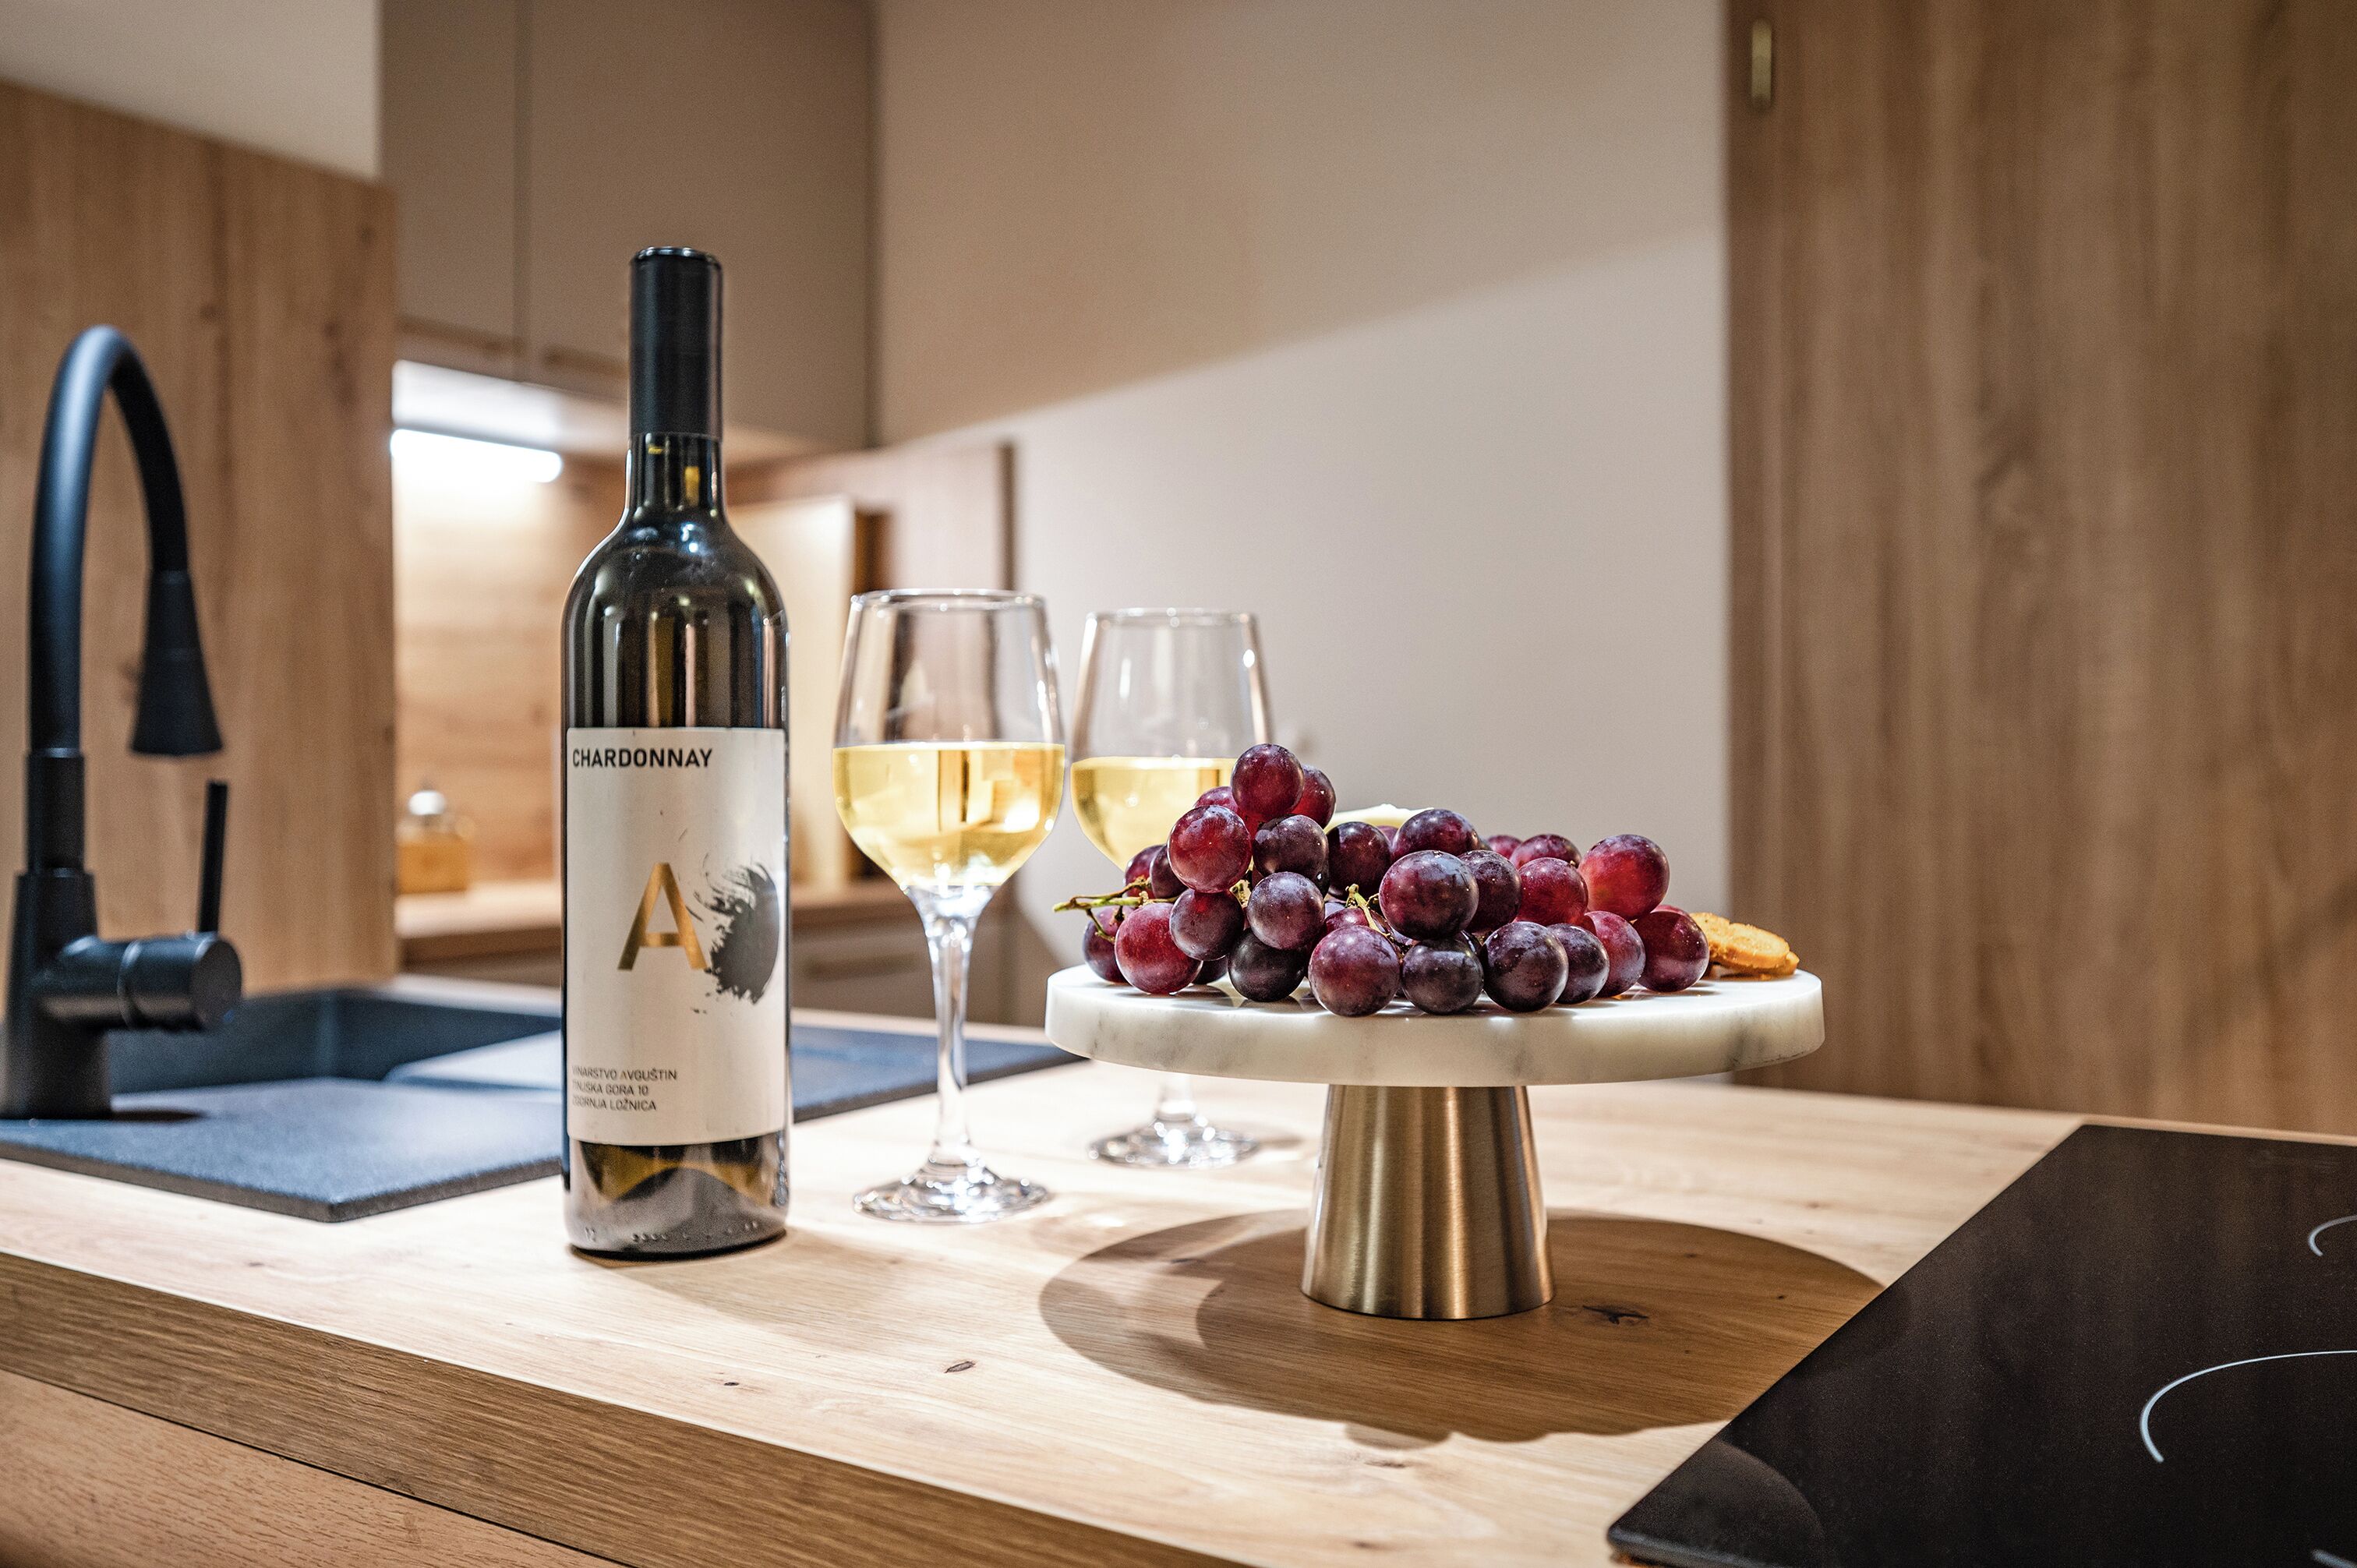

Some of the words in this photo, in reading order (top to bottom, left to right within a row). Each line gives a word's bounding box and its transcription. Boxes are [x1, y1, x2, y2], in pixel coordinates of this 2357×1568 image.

[572, 748, 712, 768] CHARDONNAY
[617, 862, 709, 970] A
[571, 1065, 617, 1080] VINARSTVO
[620, 1067, 677, 1082] AVGUŠTIN
[606, 1083, 634, 1095] GORA
[638, 1084, 648, 1096] 10
[610, 1097, 656, 1111] LOŽNICA
